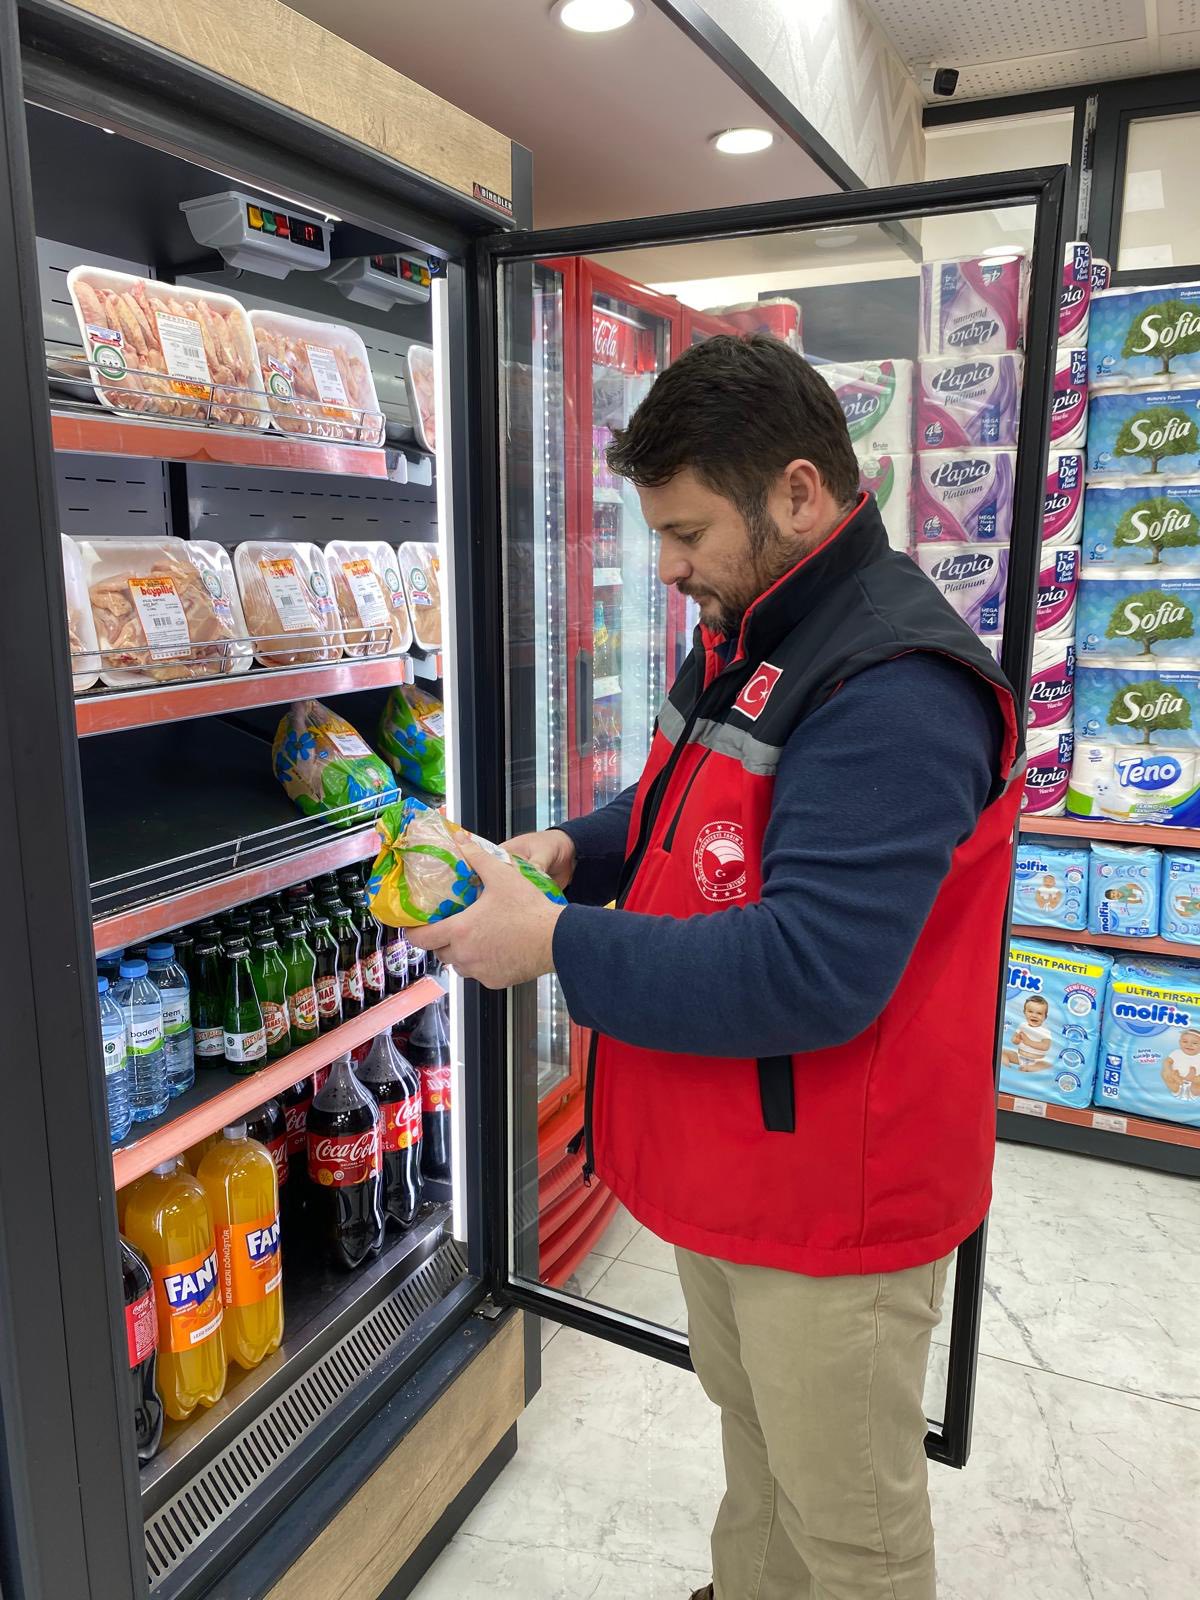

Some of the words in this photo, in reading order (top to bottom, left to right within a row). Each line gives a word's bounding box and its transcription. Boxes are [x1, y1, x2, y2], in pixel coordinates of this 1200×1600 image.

[1060, 284, 1081, 304] pia
[950, 320, 996, 348] Papia
[1132, 312, 1200, 353] Sofia
[936, 362, 992, 392] Papia
[844, 392, 874, 418] pia
[944, 388, 986, 406] Platinum
[1052, 388, 1078, 413] pia
[1123, 418, 1192, 454] Sofia
[935, 459, 988, 486] Papia
[1060, 466, 1078, 478] Dev
[943, 486, 982, 501] Platinum
[1044, 492, 1068, 510] pia
[1122, 508, 1192, 544] Sofia
[1057, 560, 1075, 572] Dev
[1058, 552, 1074, 560] 1=2
[1090, 551, 1095, 560] 3
[936, 554, 990, 580] Papia
[944, 579, 986, 594] Platinum
[1038, 586, 1064, 608] pia
[1115, 602, 1186, 636] Sofia
[1082, 642, 1088, 650] 3
[1030, 680, 1072, 700] Papia
[1116, 692, 1184, 723] Sofia
[1082, 726, 1088, 736] 3
[1026, 766, 1066, 786] Papia
[1120, 757, 1176, 786] Teno
[1100, 902, 1109, 932] molfix
[1016, 954, 1050, 967] FIRSAT
[1052, 961, 1088, 974] PAKETİ
[1008, 967, 1041, 991] lfix
[318, 986, 334, 1000] NAR
[1126, 986, 1160, 998] ULTRA
[1163, 992, 1200, 1004] FIRSAT
[162, 1010, 180, 1018] dem
[1116, 1004, 1188, 1026] molfix
[1110, 1072, 1119, 1082] 3
[1104, 1086, 1118, 1096] 108
[316, 1130, 378, 1162] Coca-Col
[247, 1213, 280, 1256] FAN
[165, 1248, 218, 1303] FANT
